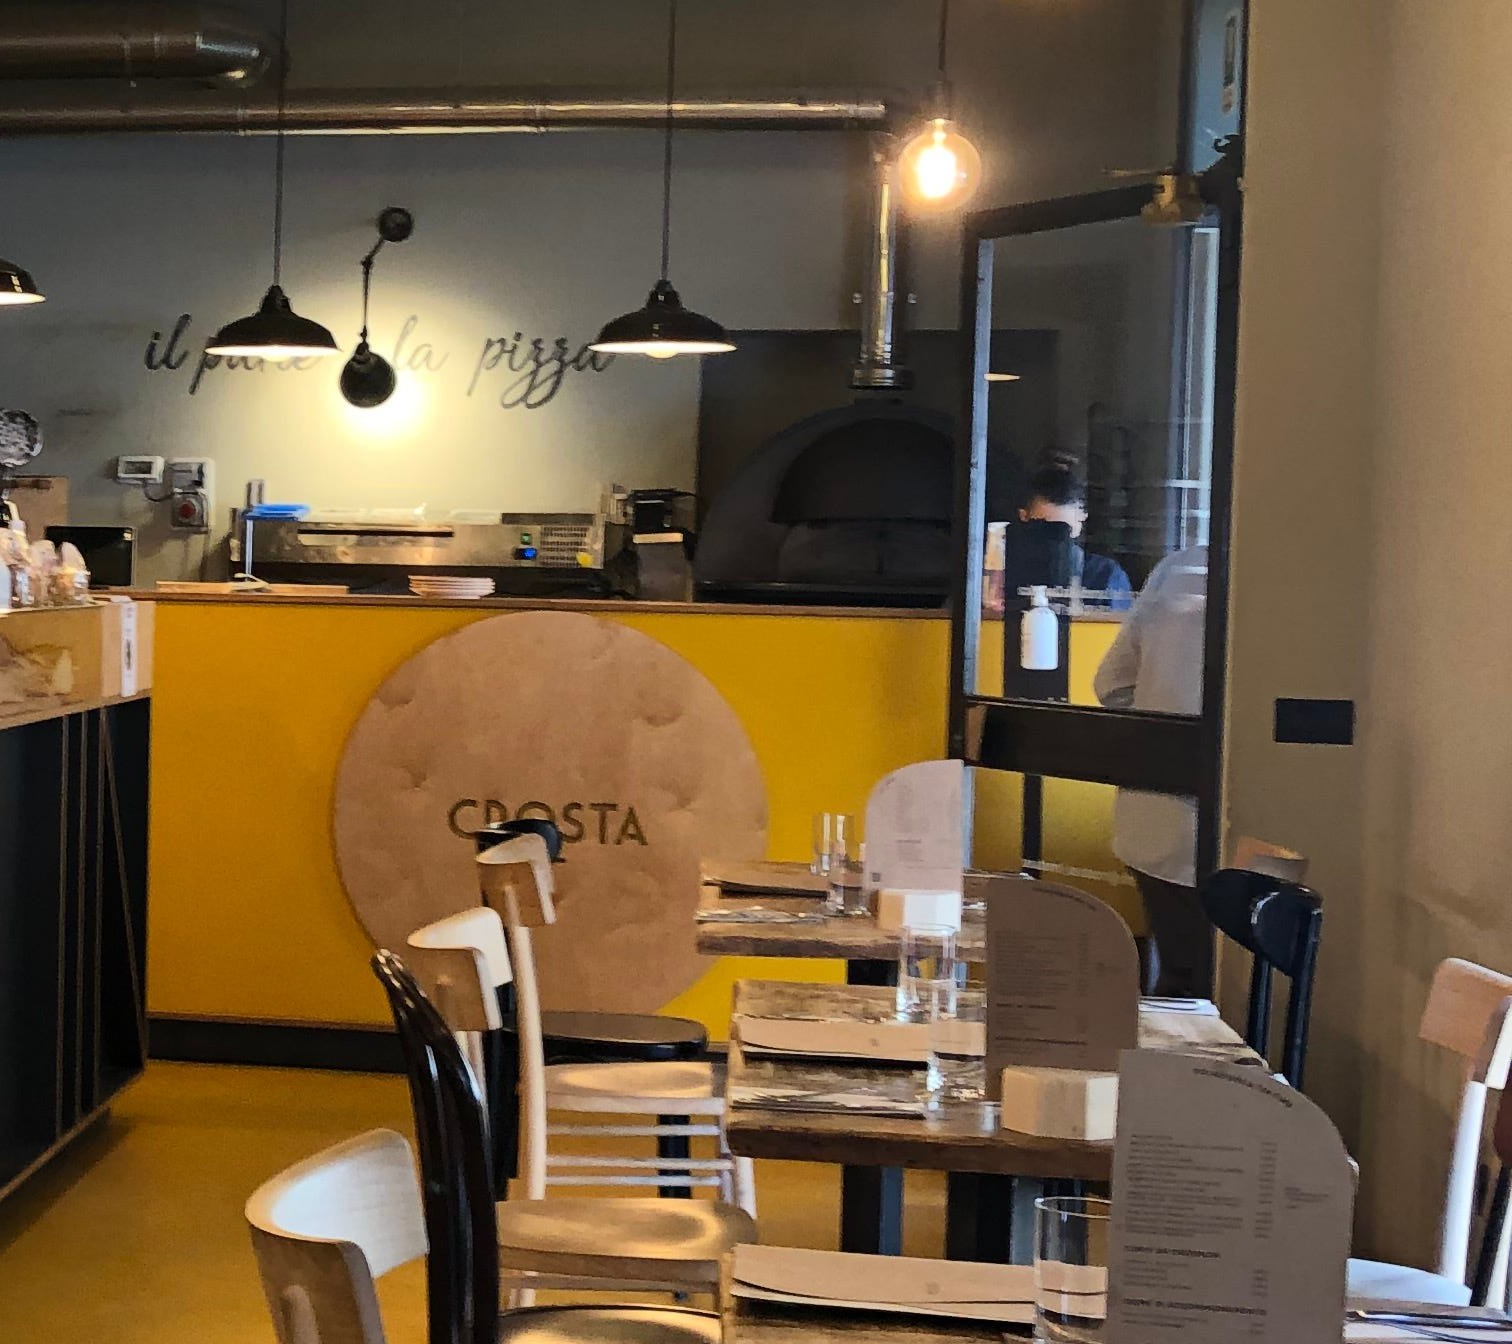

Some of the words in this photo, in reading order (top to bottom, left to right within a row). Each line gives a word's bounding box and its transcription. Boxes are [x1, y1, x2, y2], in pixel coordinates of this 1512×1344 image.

[144, 313, 192, 371] il
[392, 314, 450, 372] la
[466, 331, 617, 409] pizza
